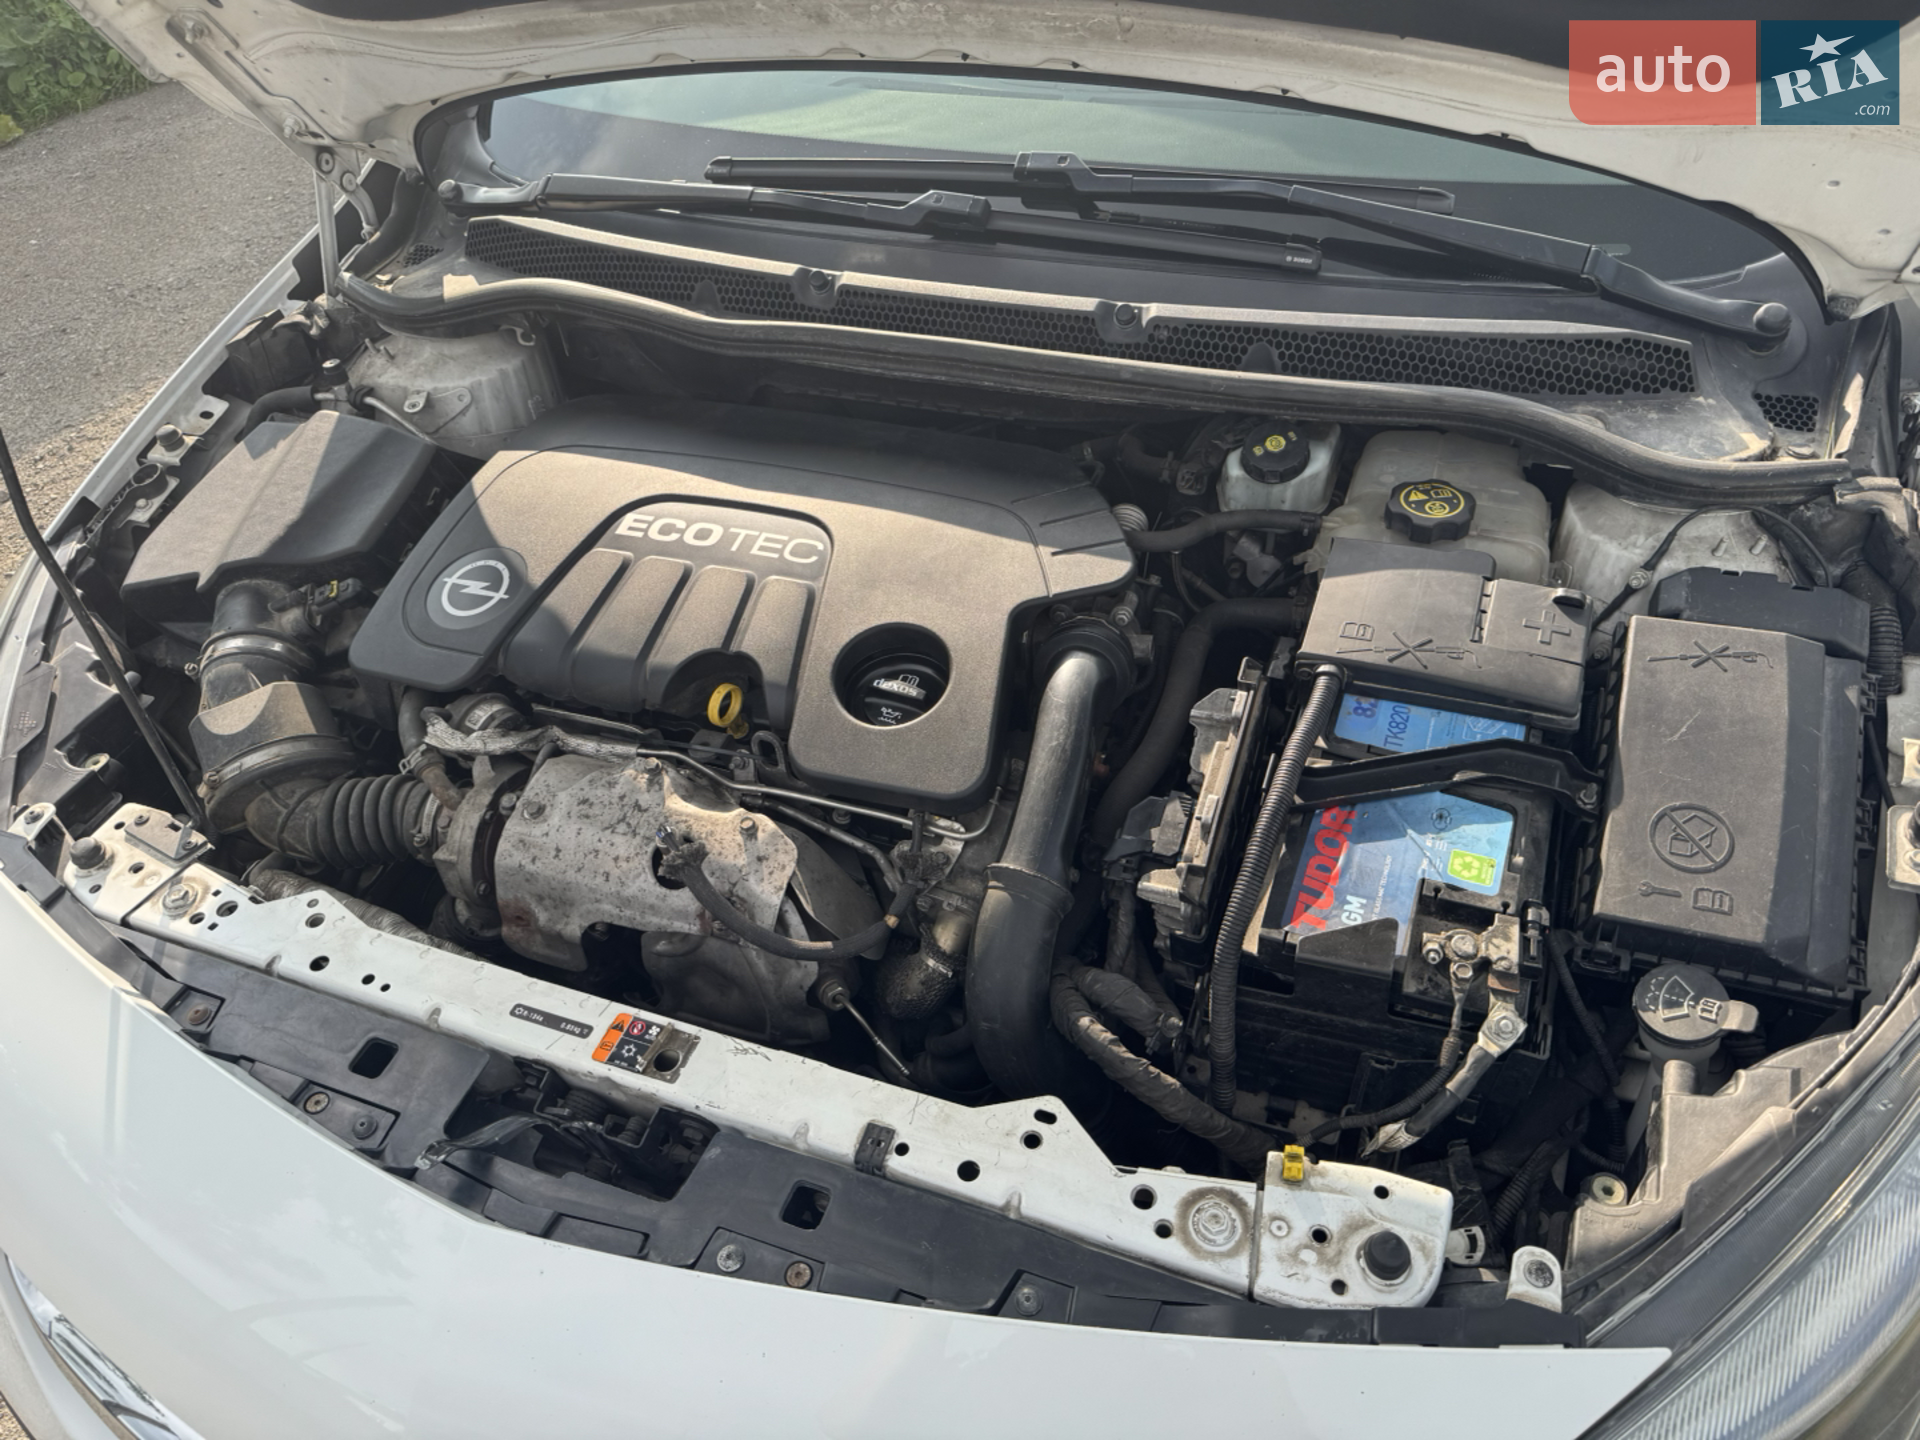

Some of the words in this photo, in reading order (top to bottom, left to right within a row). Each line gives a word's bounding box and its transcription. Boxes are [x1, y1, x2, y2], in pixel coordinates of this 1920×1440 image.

[614, 512, 825, 564] ECOTEC
[872, 678, 918, 697] dexos
[1383, 704, 1412, 749] TK820
[1289, 804, 1358, 931] TUDOR
[1341, 895, 1368, 926] GM
